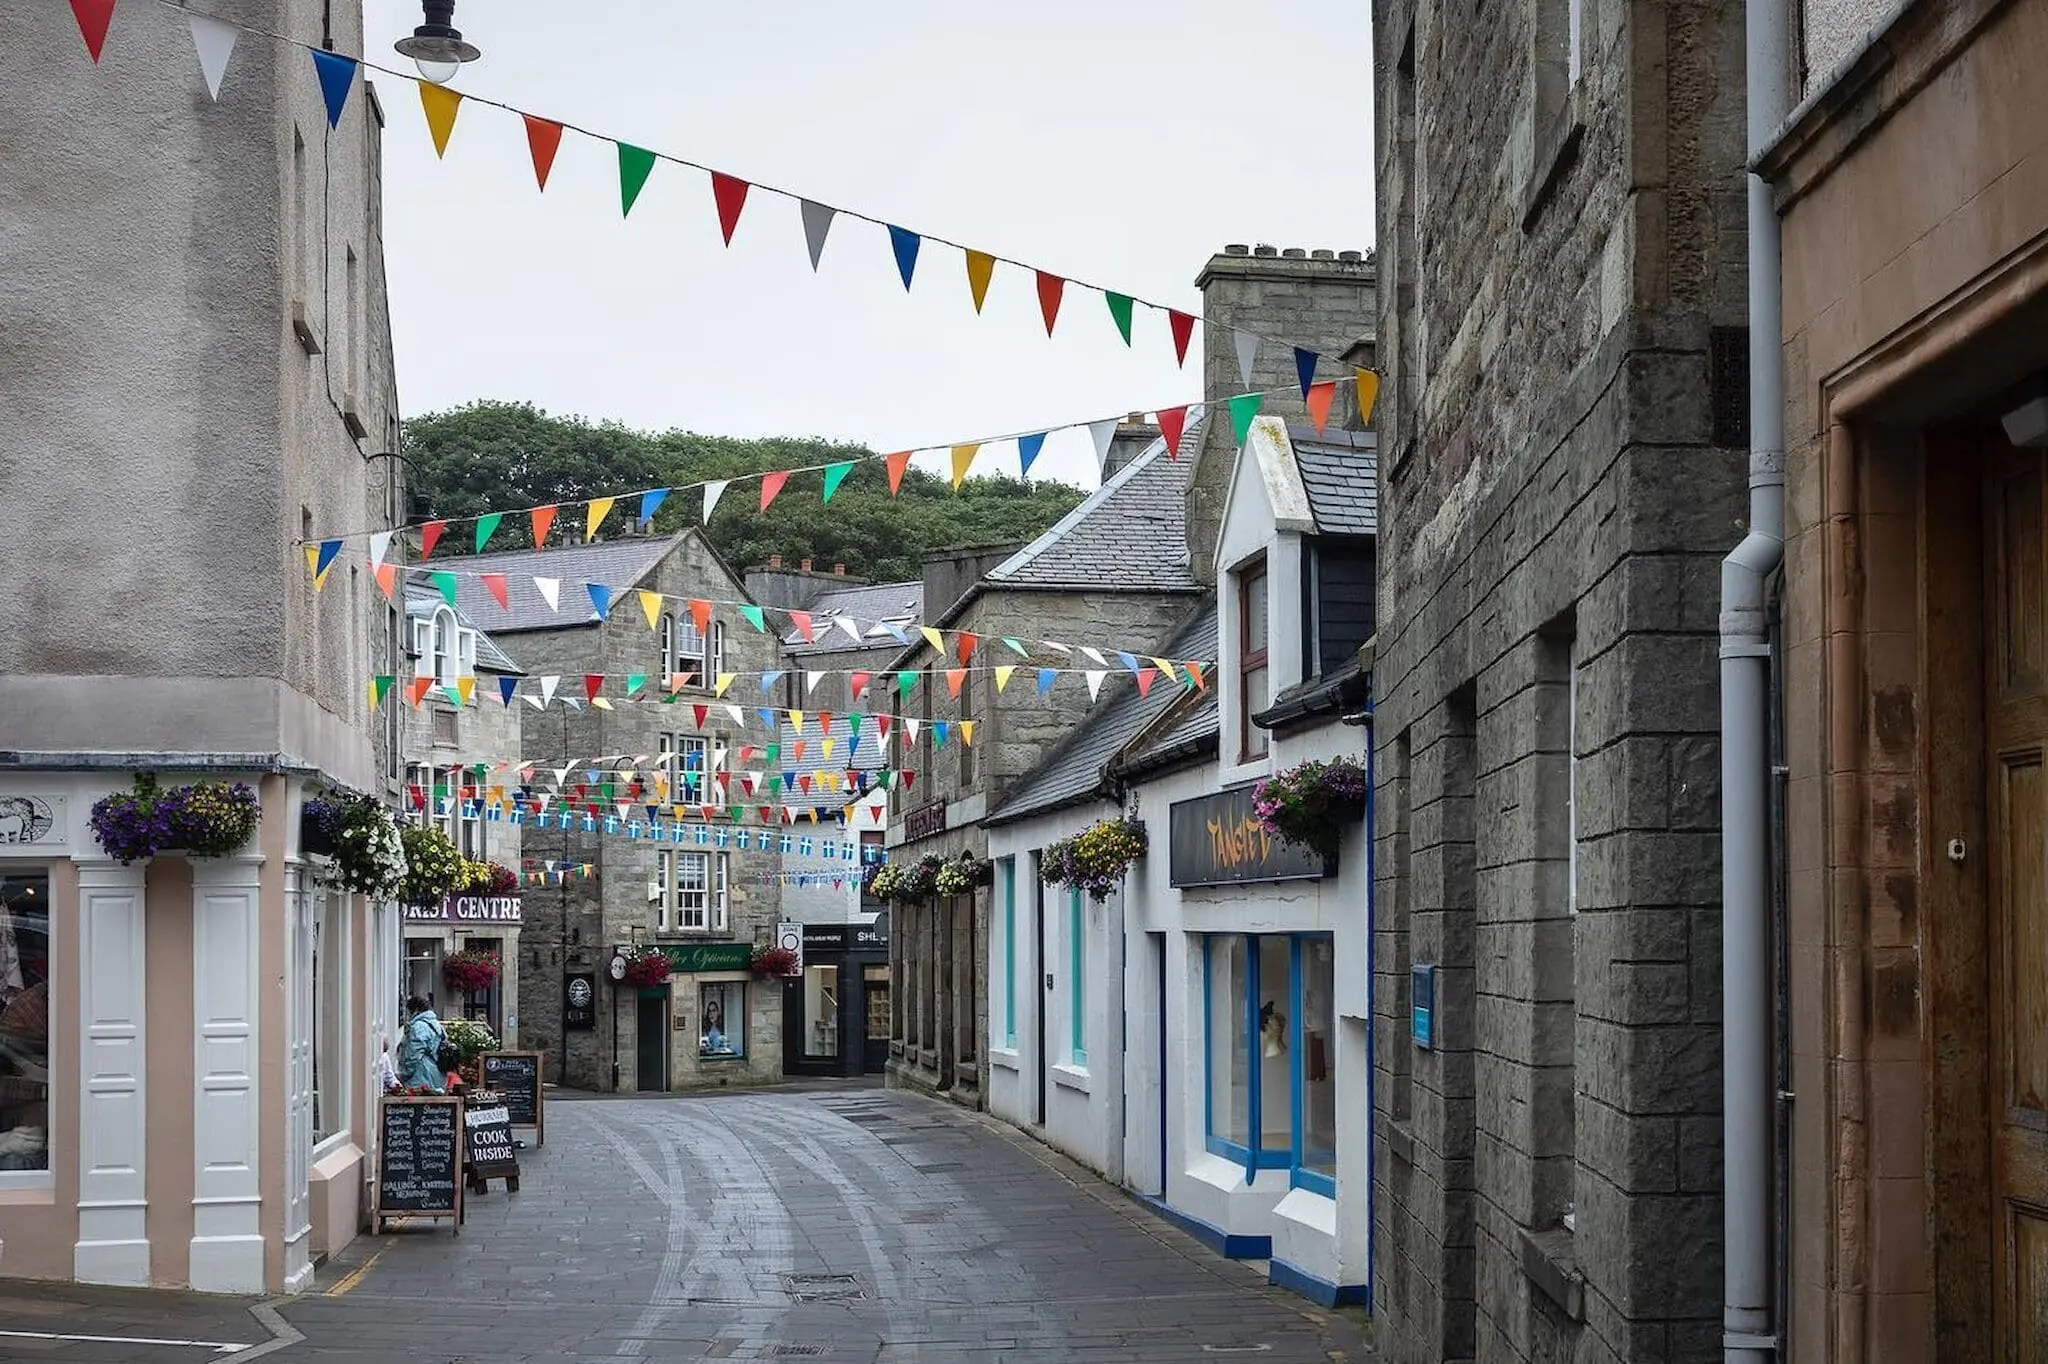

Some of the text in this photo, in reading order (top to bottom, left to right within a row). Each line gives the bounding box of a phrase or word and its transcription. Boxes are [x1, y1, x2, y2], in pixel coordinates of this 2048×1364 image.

[457, 896, 521, 920] CENTRE
[473, 1129, 509, 1145] COOK
[473, 1146, 514, 1162] INSIDE
